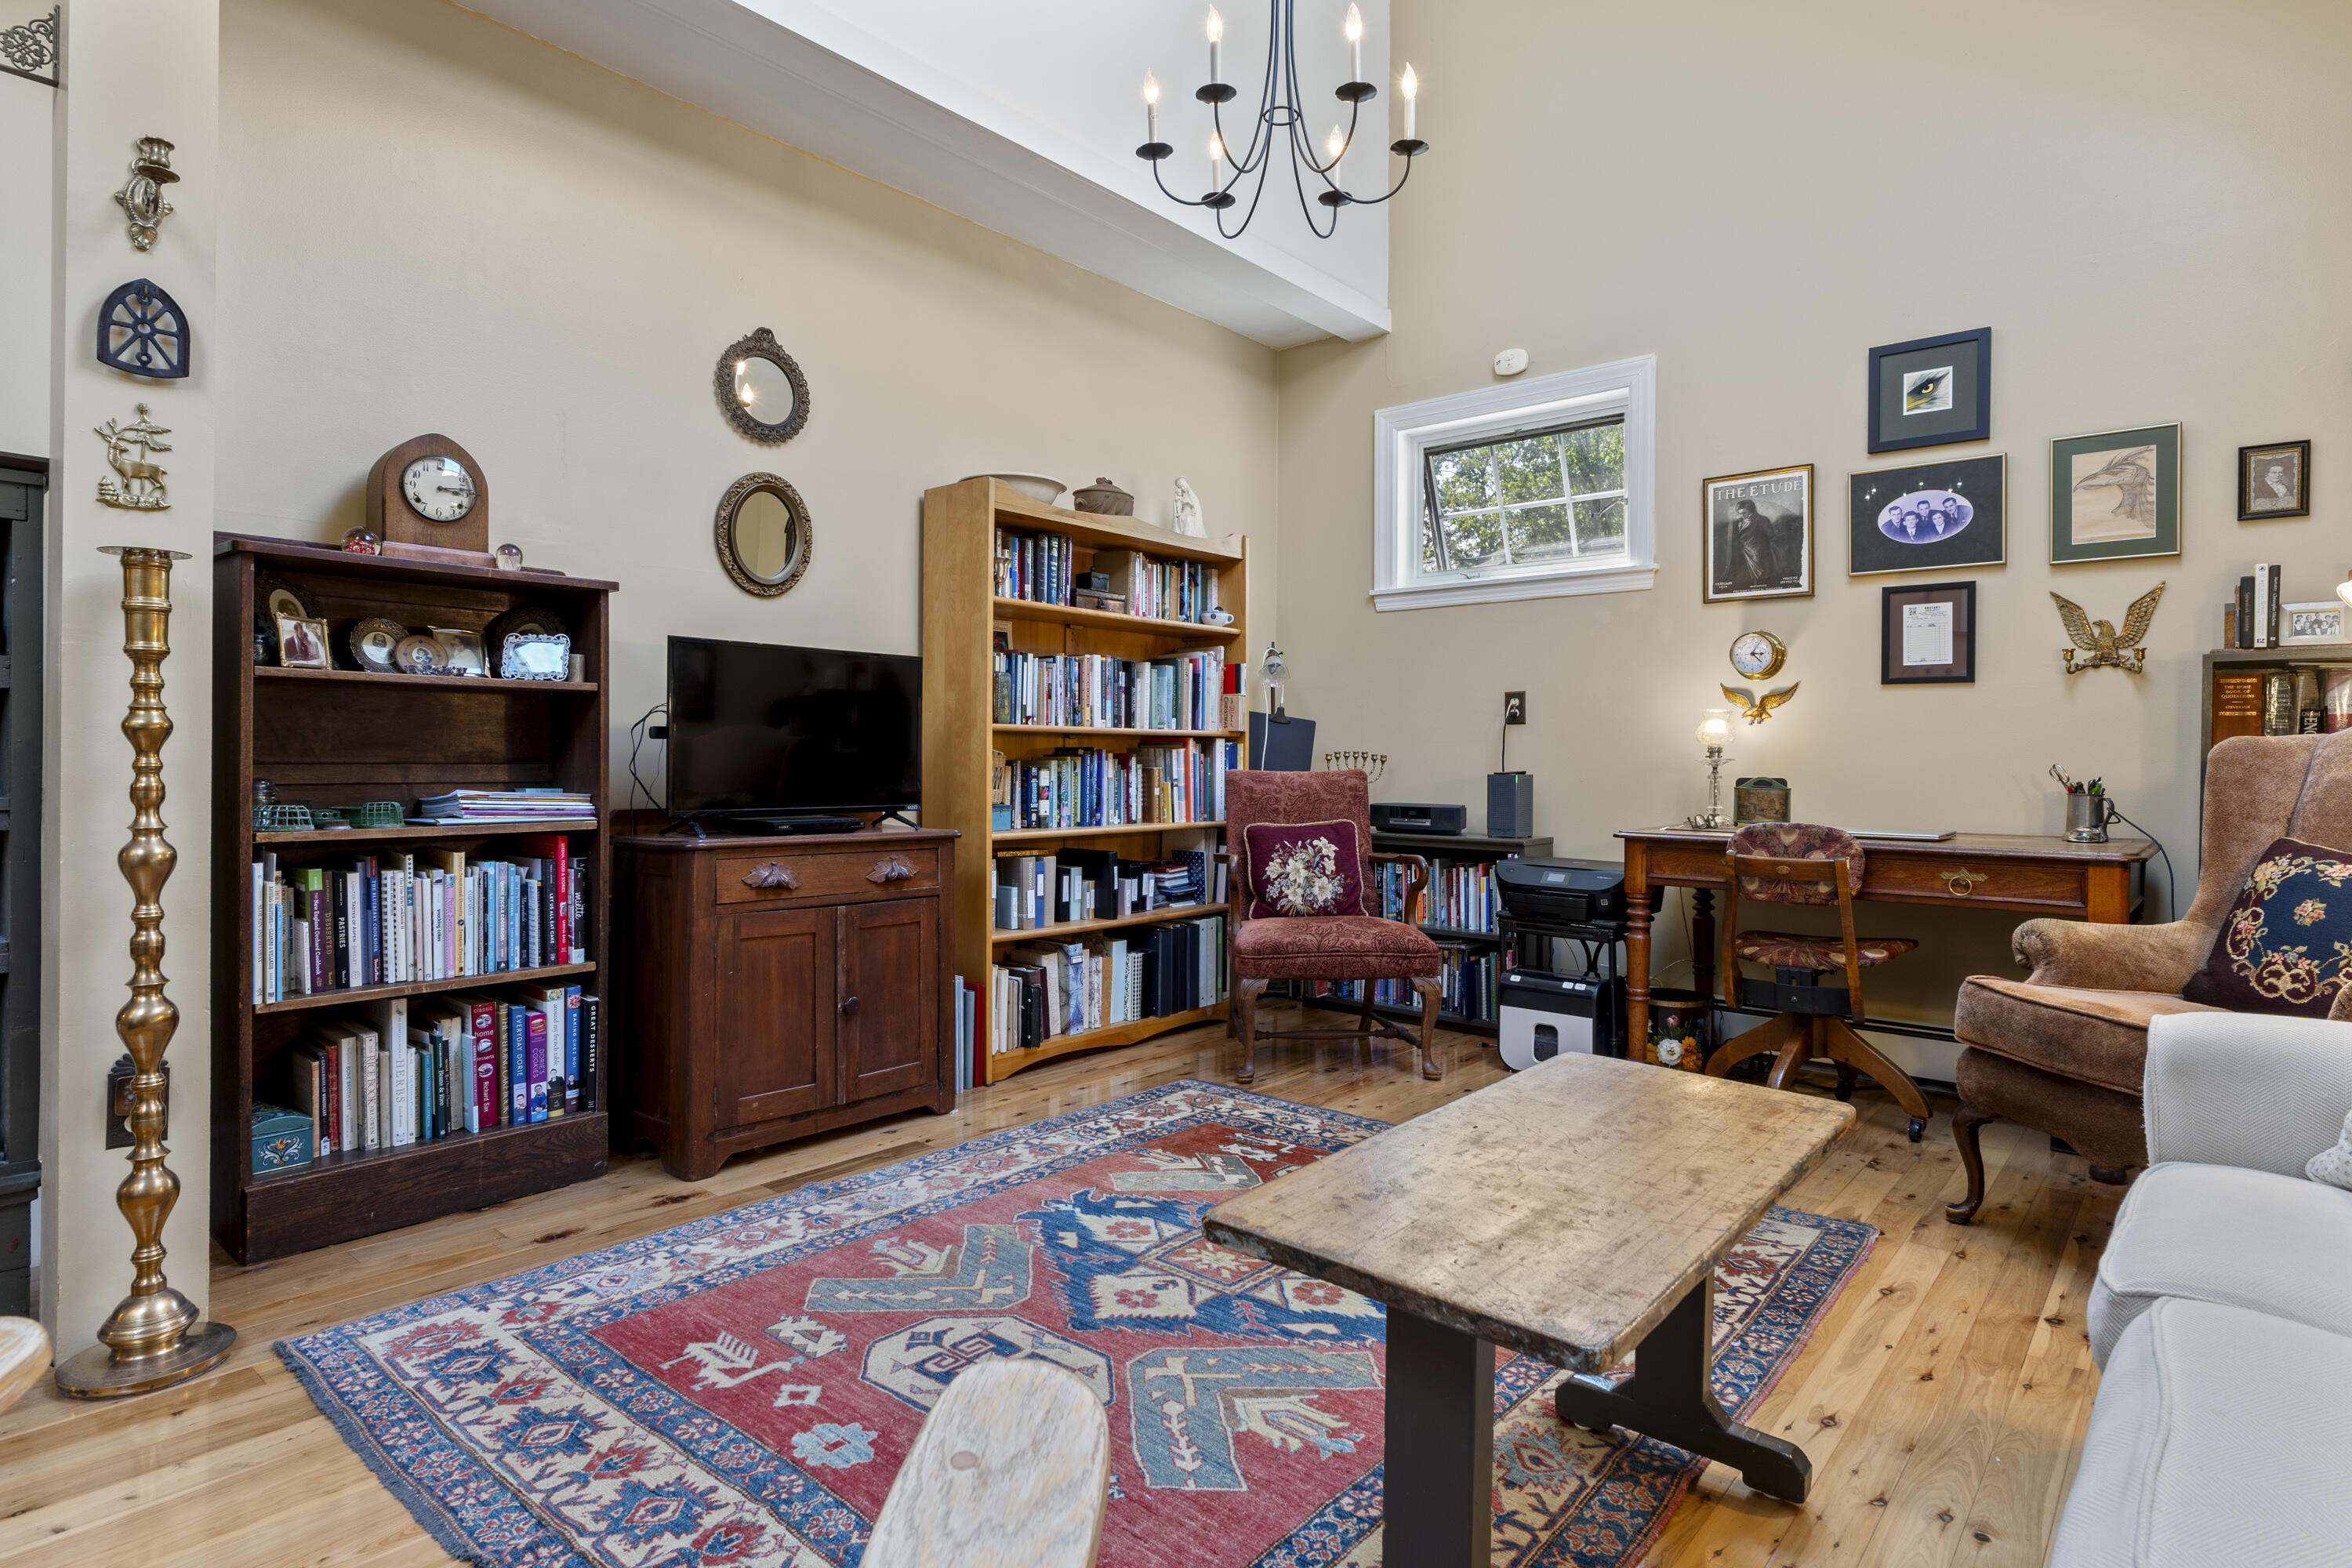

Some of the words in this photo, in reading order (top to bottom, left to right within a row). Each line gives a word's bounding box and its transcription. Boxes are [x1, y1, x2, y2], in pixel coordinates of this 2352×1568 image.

[409, 480, 416, 489] 9
[1715, 487, 1745, 500] THE
[1750, 480, 1802, 497] ETUDE
[421, 502, 428, 511] 7
[436, 507, 442, 517] 6
[575, 892, 583, 920] miette
[474, 1029, 494, 1038] home
[553, 1024, 558, 1033] my
[367, 1055, 376, 1077] RICE
[395, 1060, 405, 1103] HERBS
[367, 1080, 376, 1105] BOOK
